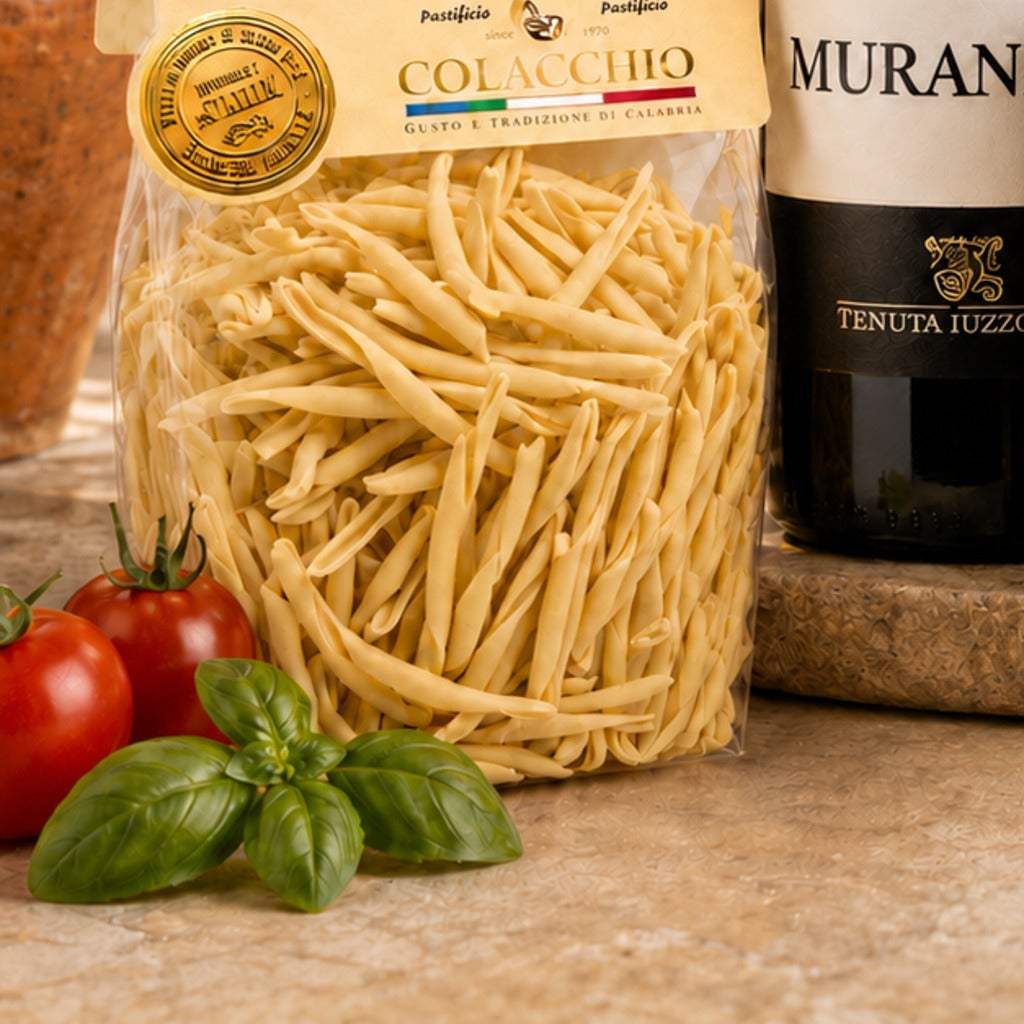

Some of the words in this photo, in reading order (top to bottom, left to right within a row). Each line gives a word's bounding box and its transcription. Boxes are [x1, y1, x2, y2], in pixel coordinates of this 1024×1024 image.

[421, 4, 491, 24] Pastificio
[399, 45, 695, 96] COLACCHIO
[404, 119, 462, 134] GUSTO
[472, 120, 481, 130] E
[491, 111, 592, 128] TRADIZIONE
[599, 110, 616, 121] DI
[625, 104, 703, 120] CALABRIA
[837, 306, 943, 334] TENUTA
